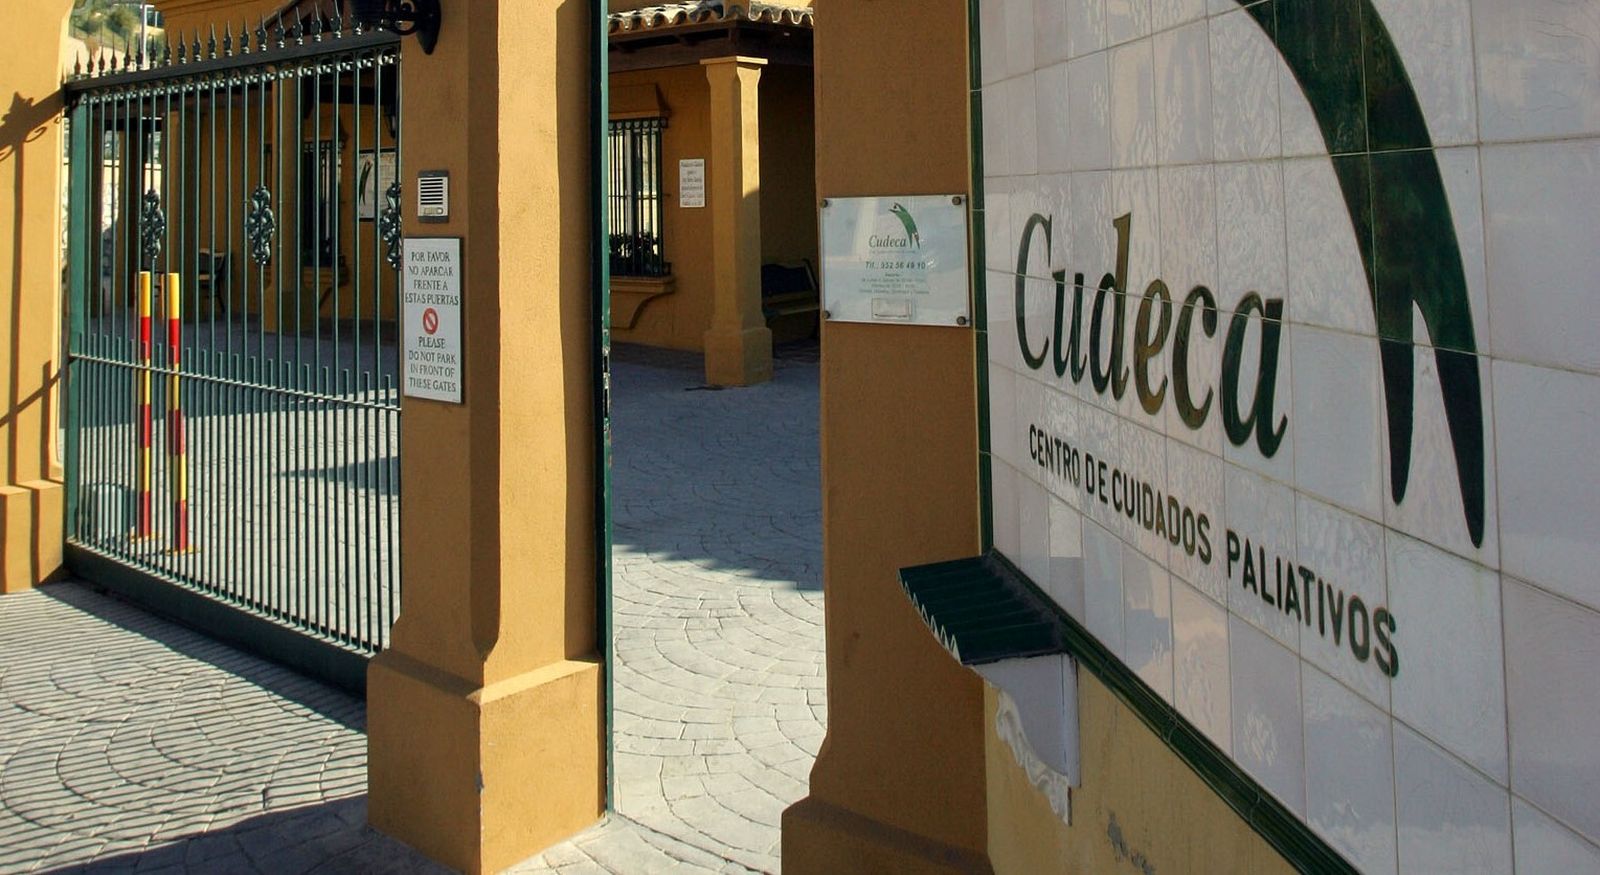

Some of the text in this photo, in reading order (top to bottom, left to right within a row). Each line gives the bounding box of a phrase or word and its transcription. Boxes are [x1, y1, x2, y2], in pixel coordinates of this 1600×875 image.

[868, 235, 907, 248] Cudeca
[411, 251, 450, 262] POR FAVOR
[408, 265, 453, 277] NO APARCAR
[413, 279, 449, 291] FRENTE A
[405, 292, 459, 306] ESTAS PUERTAS
[418, 336, 446, 349] PLEASE
[1015, 212, 1288, 459] Cudeca
[408, 350, 456, 365] DO NOT PARK
[410, 363, 456, 378] IN FRONT OF
[408, 376, 457, 393] THESE GATES
[1029, 422, 1400, 678] CENTRO DE CUIDADOS PALIATIVOS
